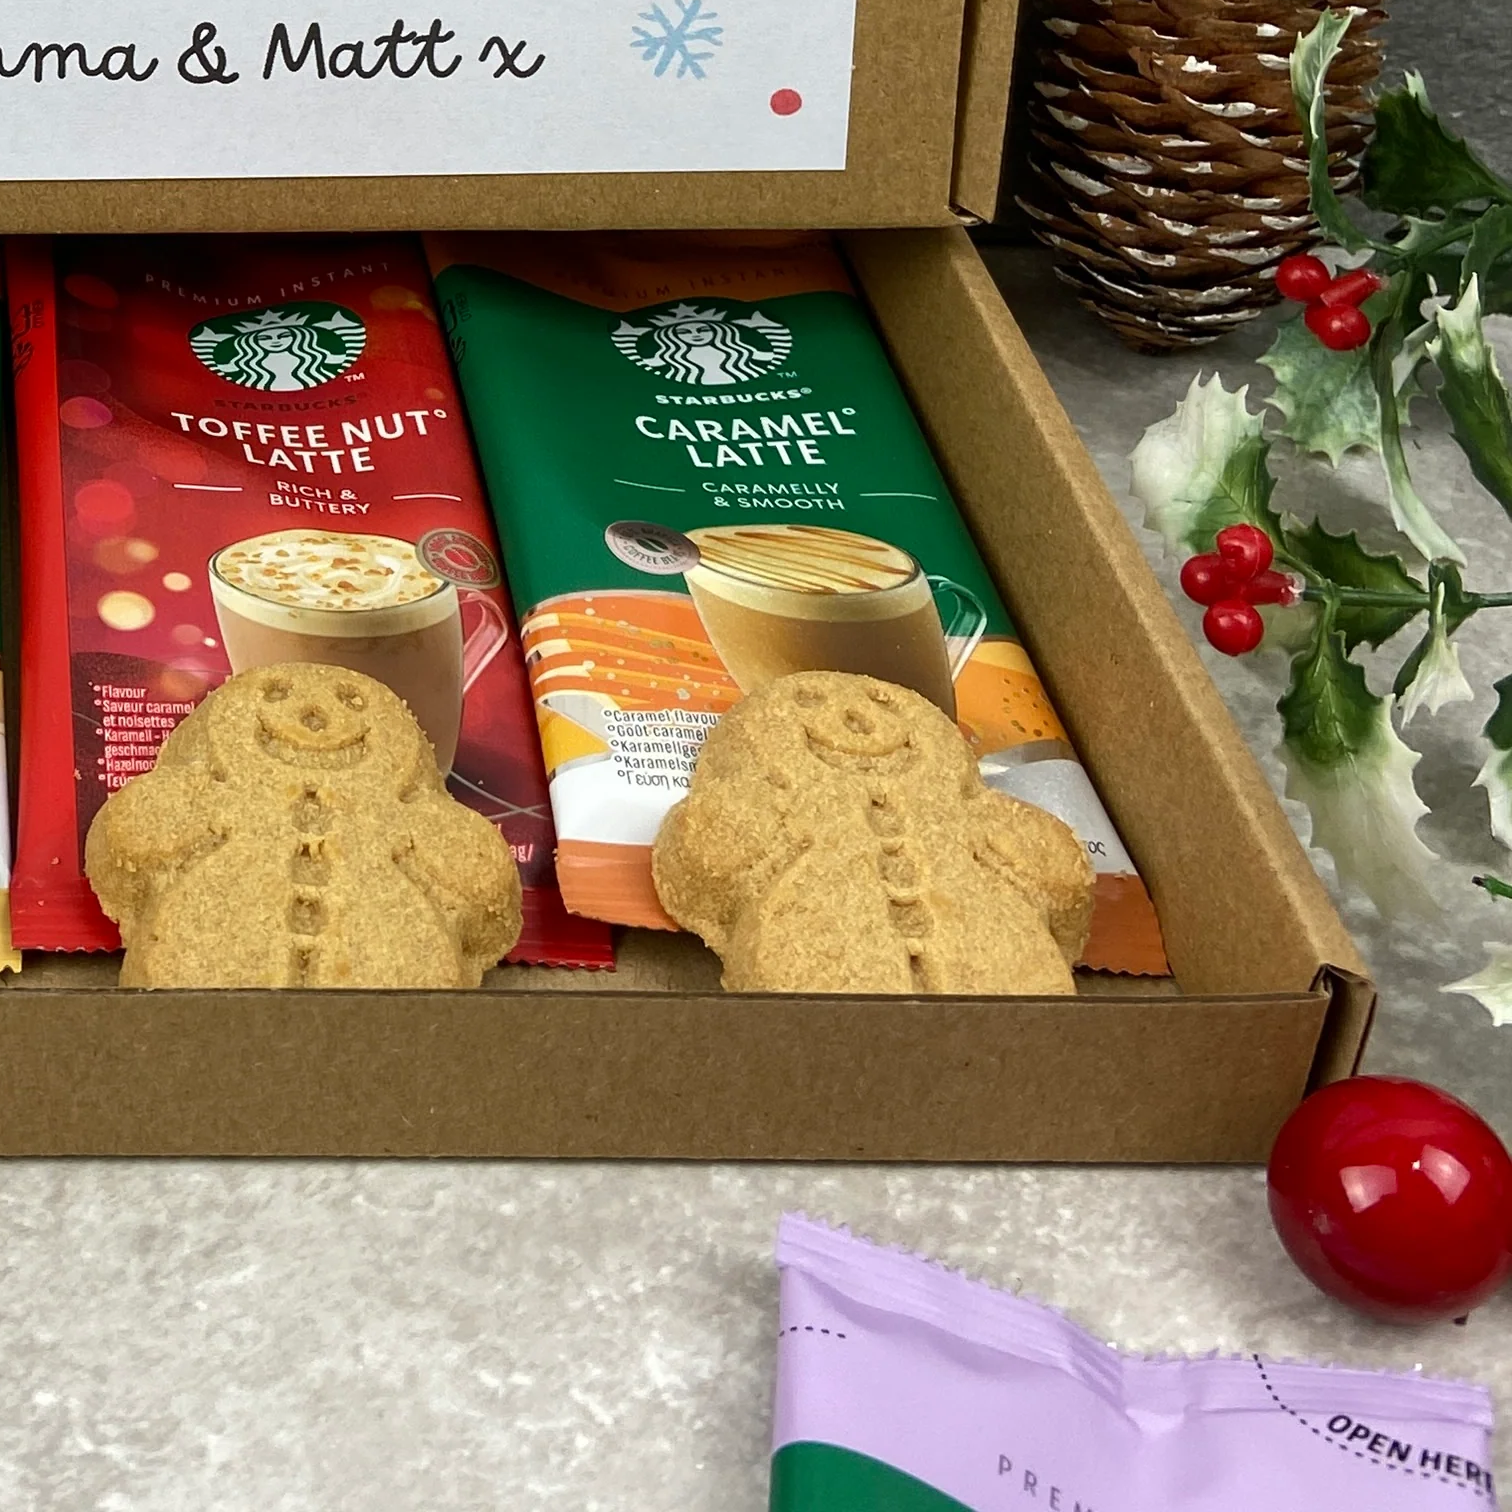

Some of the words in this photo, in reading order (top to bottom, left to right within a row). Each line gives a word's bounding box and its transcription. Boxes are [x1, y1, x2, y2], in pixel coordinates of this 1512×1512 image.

[177, 20, 239, 85] &
[262, 17, 462, 81] Matt
[477, 35, 547, 80] x
[280, 261, 389, 297] INSTANT
[171, 411, 329, 449] TOFFEE
[242, 443, 375, 474] LATTE
[686, 439, 828, 468] LATTE
[276, 479, 332, 501] RICH
[339, 489, 358, 501] &
[702, 482, 840, 496] CARAMELLY
[269, 493, 371, 515] BUTTERY
[713, 496, 731, 508] &
[737, 497, 846, 511] SMOOTH
[102, 714, 116, 727] et
[117, 714, 176, 729] noisettes
[652, 726, 708, 741] caramel
[1326, 1414, 1413, 1463] OPEN
